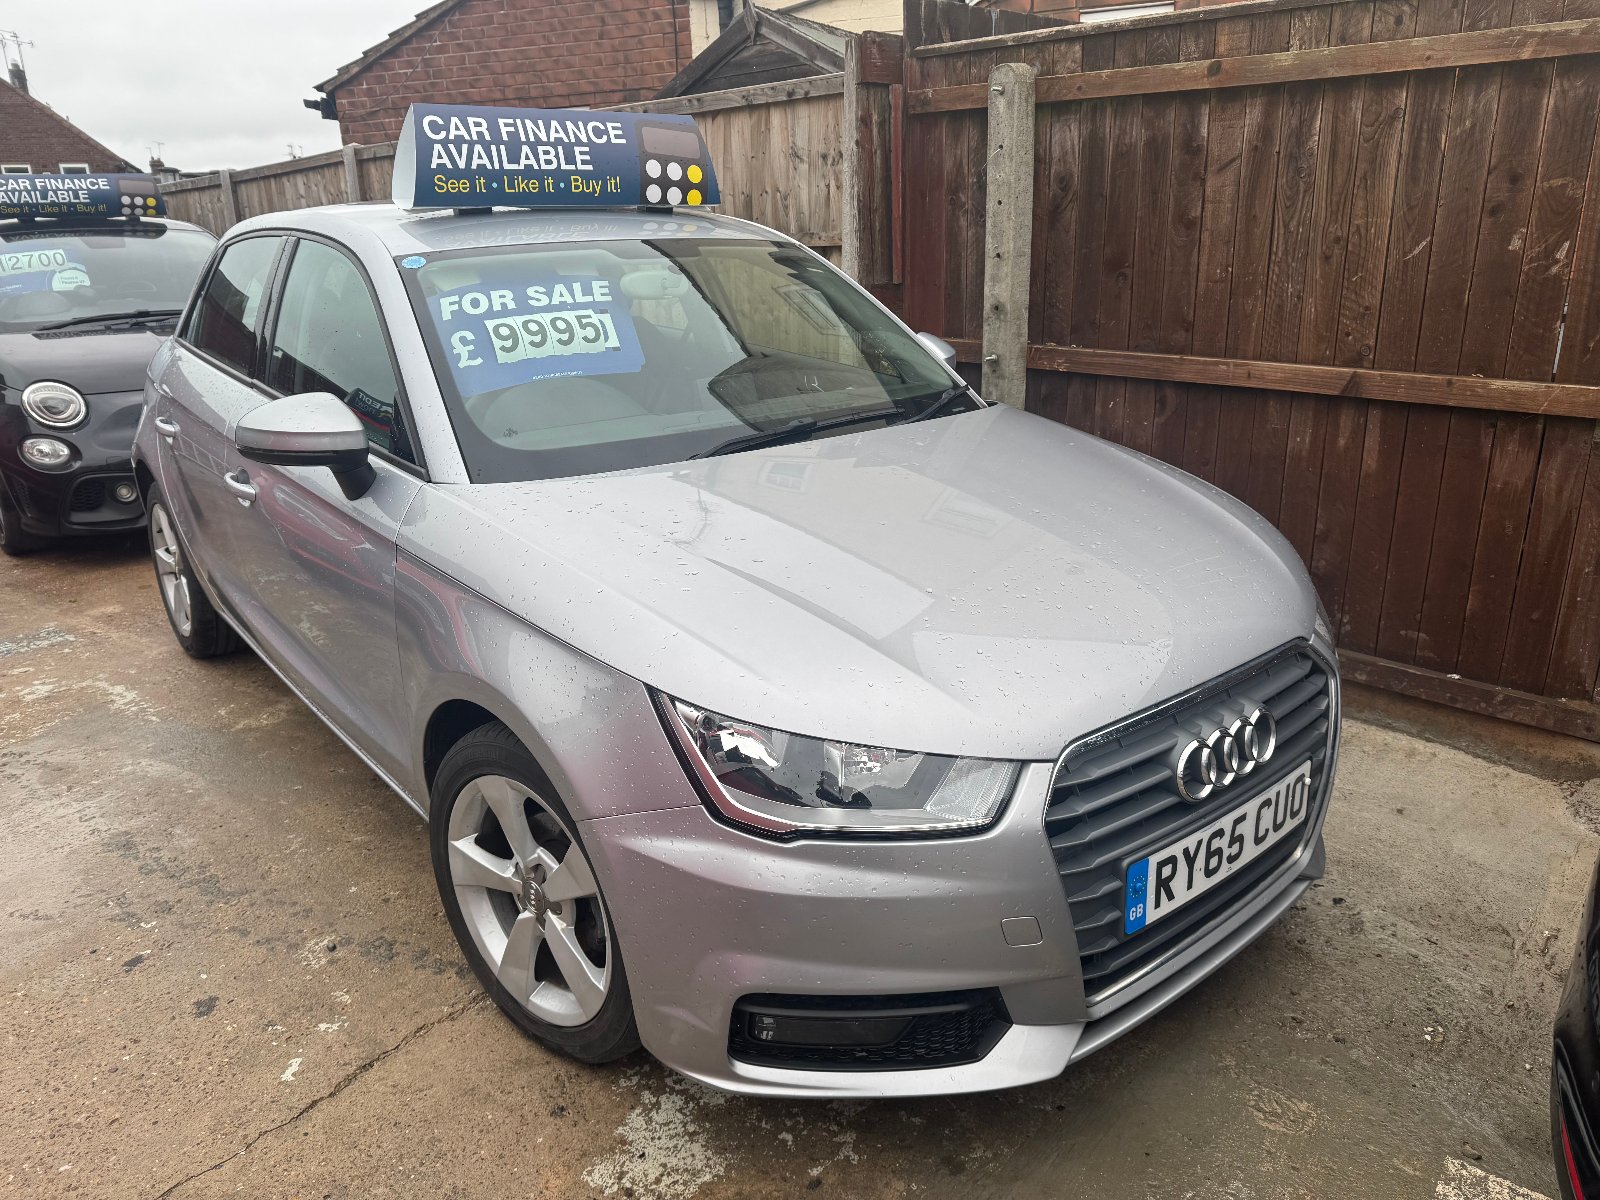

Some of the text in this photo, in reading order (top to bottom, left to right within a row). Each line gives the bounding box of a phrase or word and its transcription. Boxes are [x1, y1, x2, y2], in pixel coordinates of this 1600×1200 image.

[422, 115, 627, 144] CAR FINANCE
[430, 144, 594, 170] AVAILABLE
[35, 179, 110, 190] FINANCE
[434, 175, 621, 197] See it Like it Buy it!
[0, 191, 91, 203] AVAILABLE
[39, 204, 59, 212] Like
[62, 204, 68, 212] it
[77, 203, 95, 213] Buy
[440, 281, 612, 320] FOR SALE
[1154, 772, 1306, 910] RY65 CUO
[1129, 903, 1144, 921] GB
